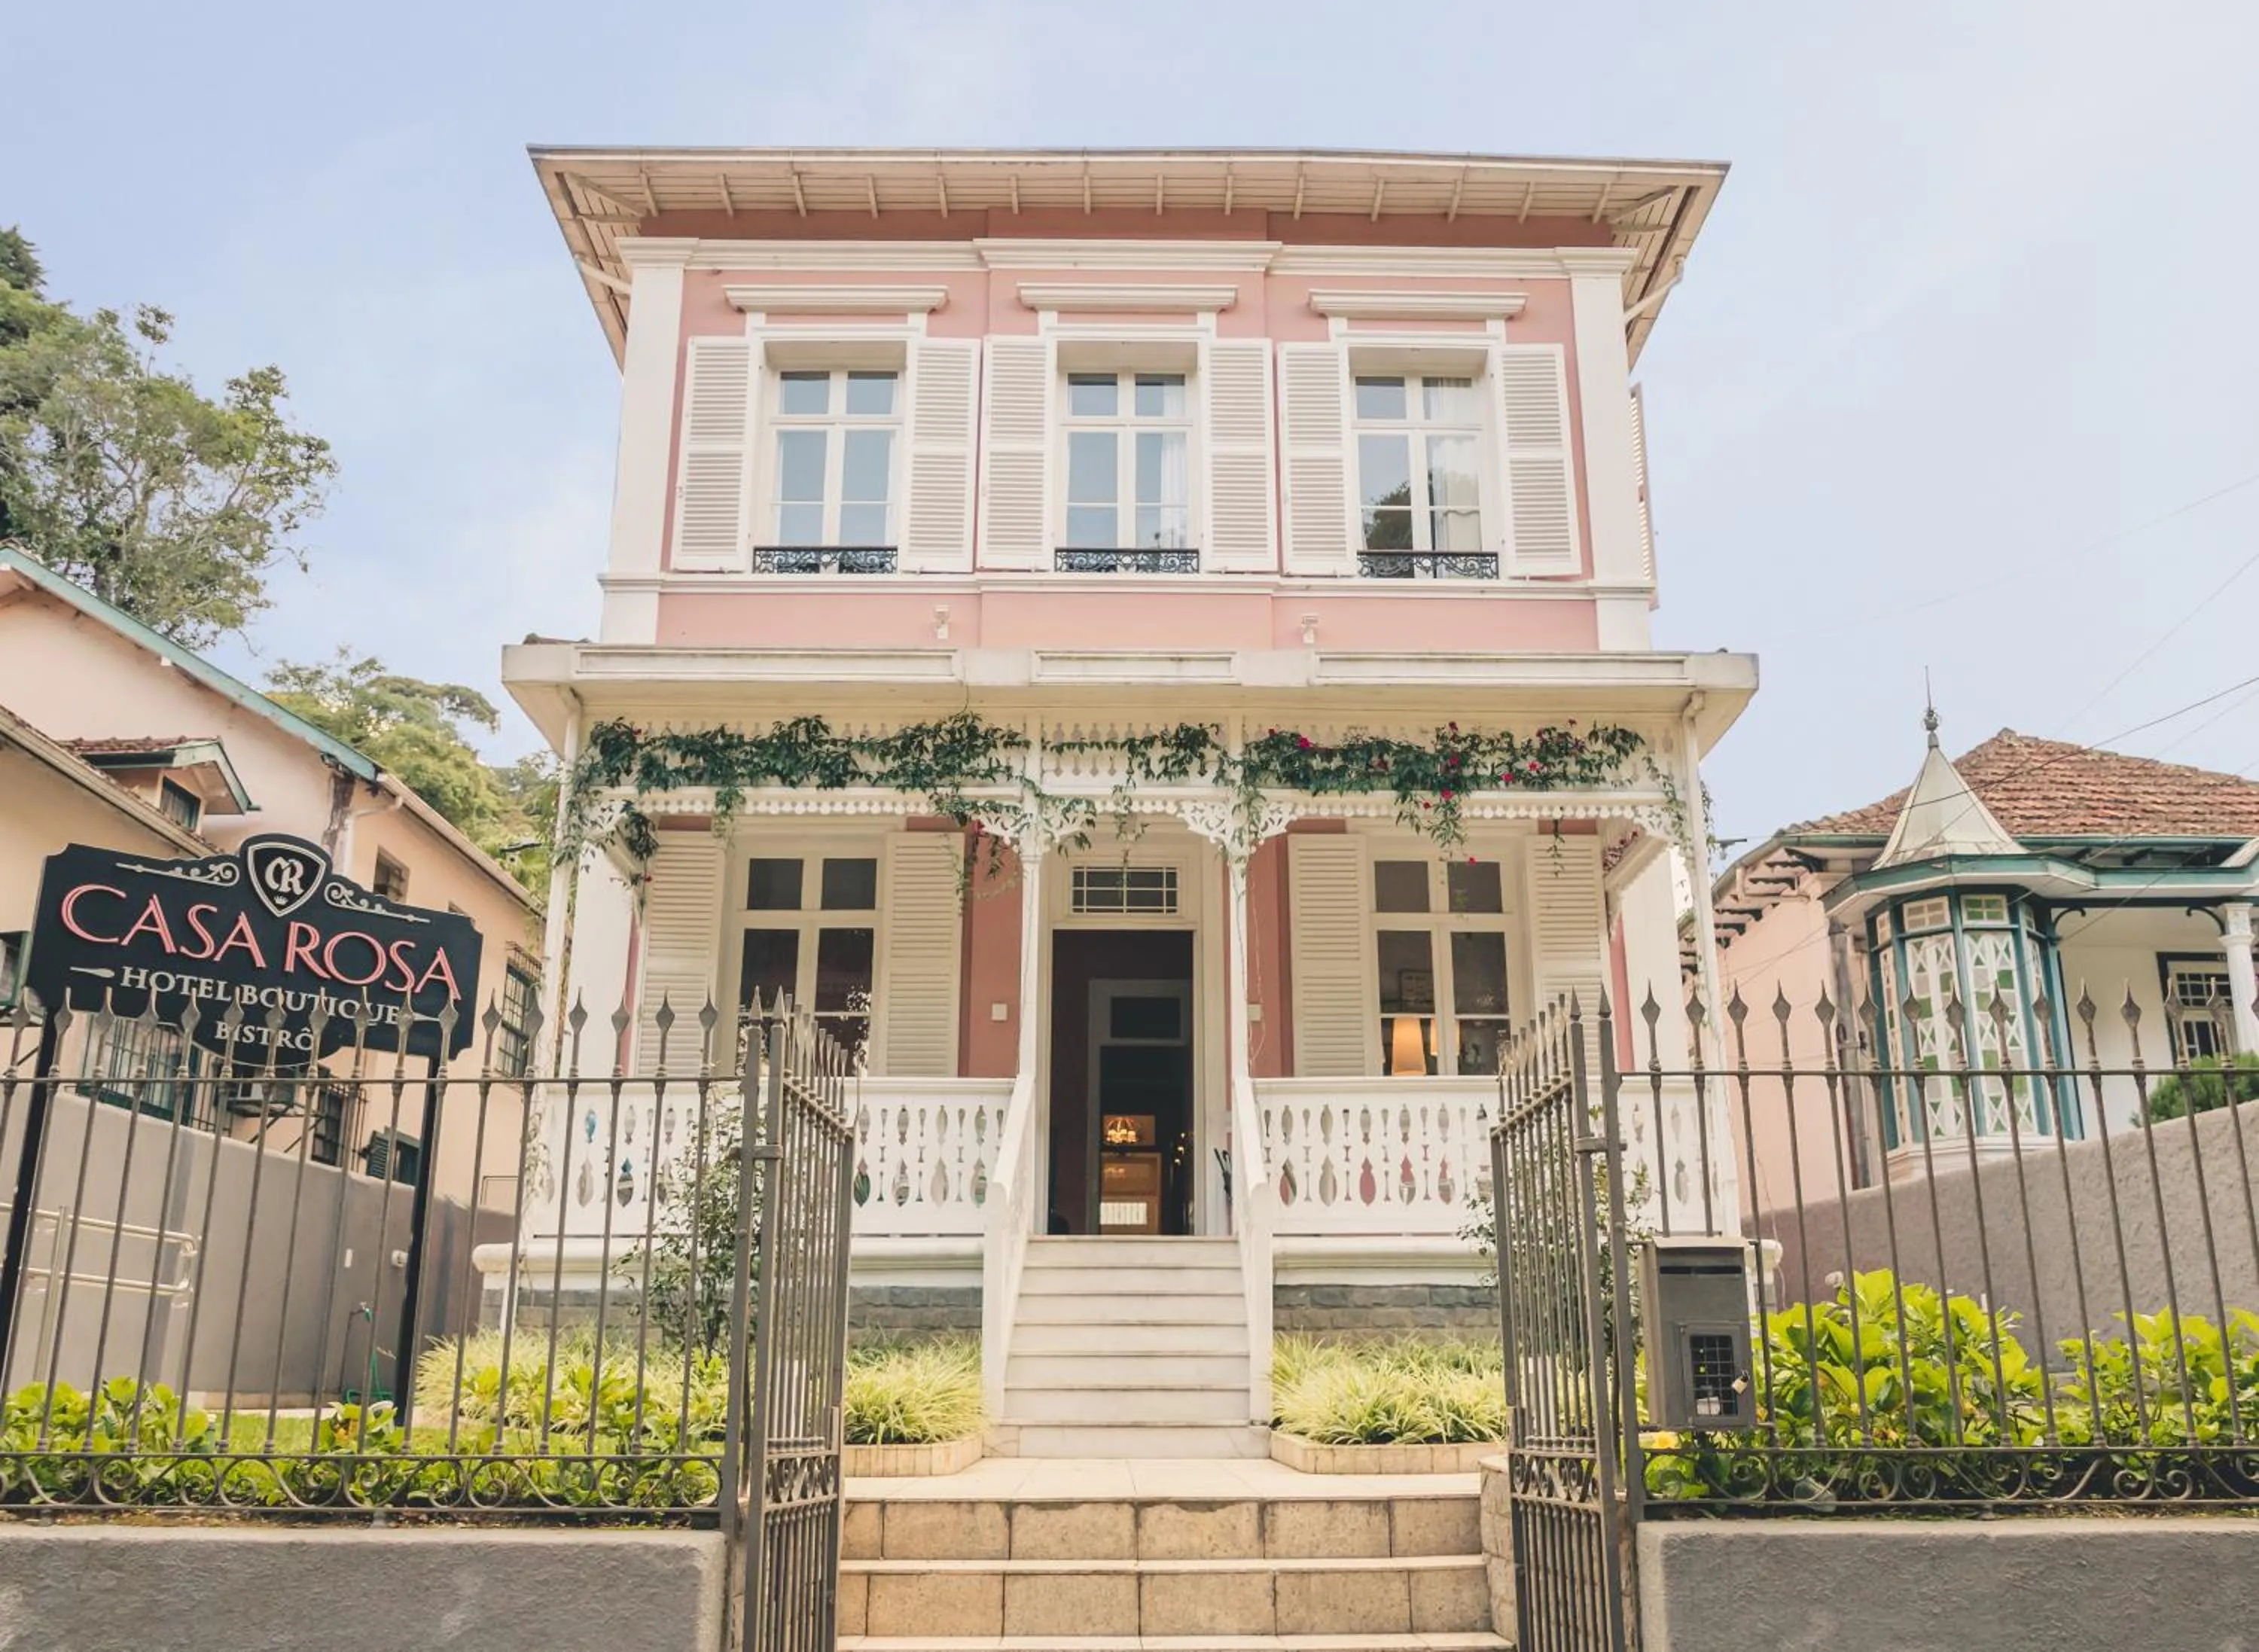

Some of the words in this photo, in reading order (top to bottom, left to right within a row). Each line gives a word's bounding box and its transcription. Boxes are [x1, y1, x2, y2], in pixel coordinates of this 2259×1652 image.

[265, 857, 304, 895] CR
[61, 885, 267, 968] CASA
[284, 921, 462, 1001] ROSA
[120, 966, 232, 1002] HOTEL
[241, 984, 403, 1025] BOUTIQUE
[215, 1021, 313, 1050] BISTRÔ
